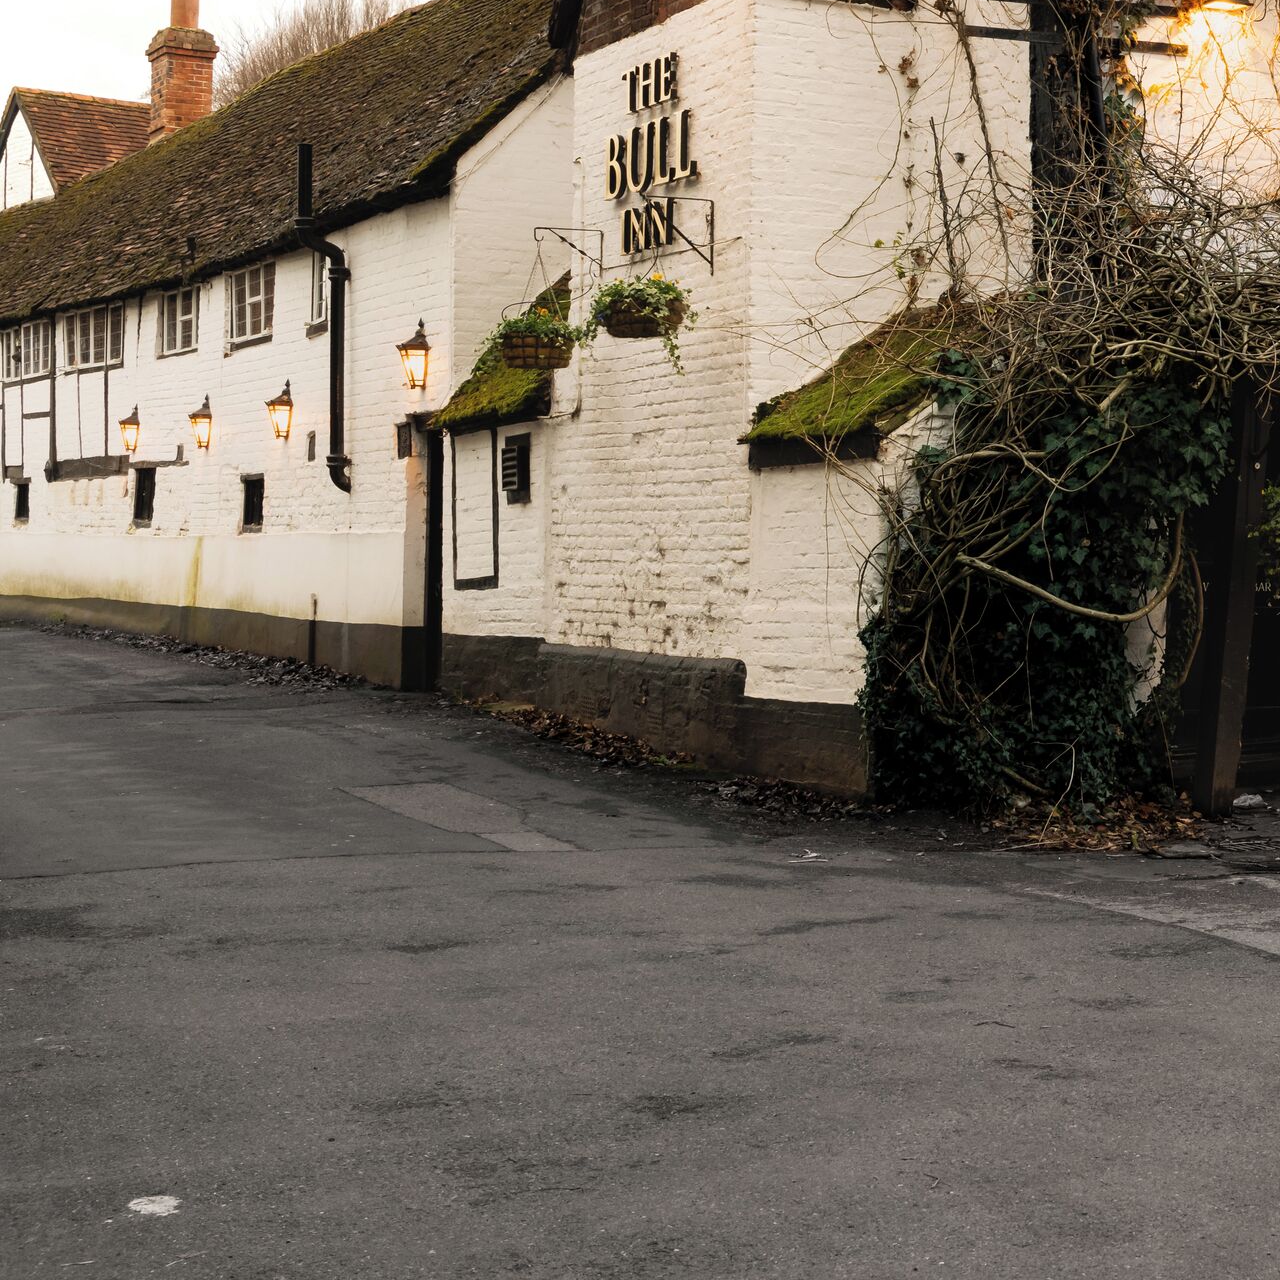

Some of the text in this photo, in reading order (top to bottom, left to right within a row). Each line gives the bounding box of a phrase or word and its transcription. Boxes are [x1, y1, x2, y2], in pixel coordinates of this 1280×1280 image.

[621, 51, 679, 116] THE
[604, 108, 698, 202] BULL
[620, 197, 677, 256] INN
